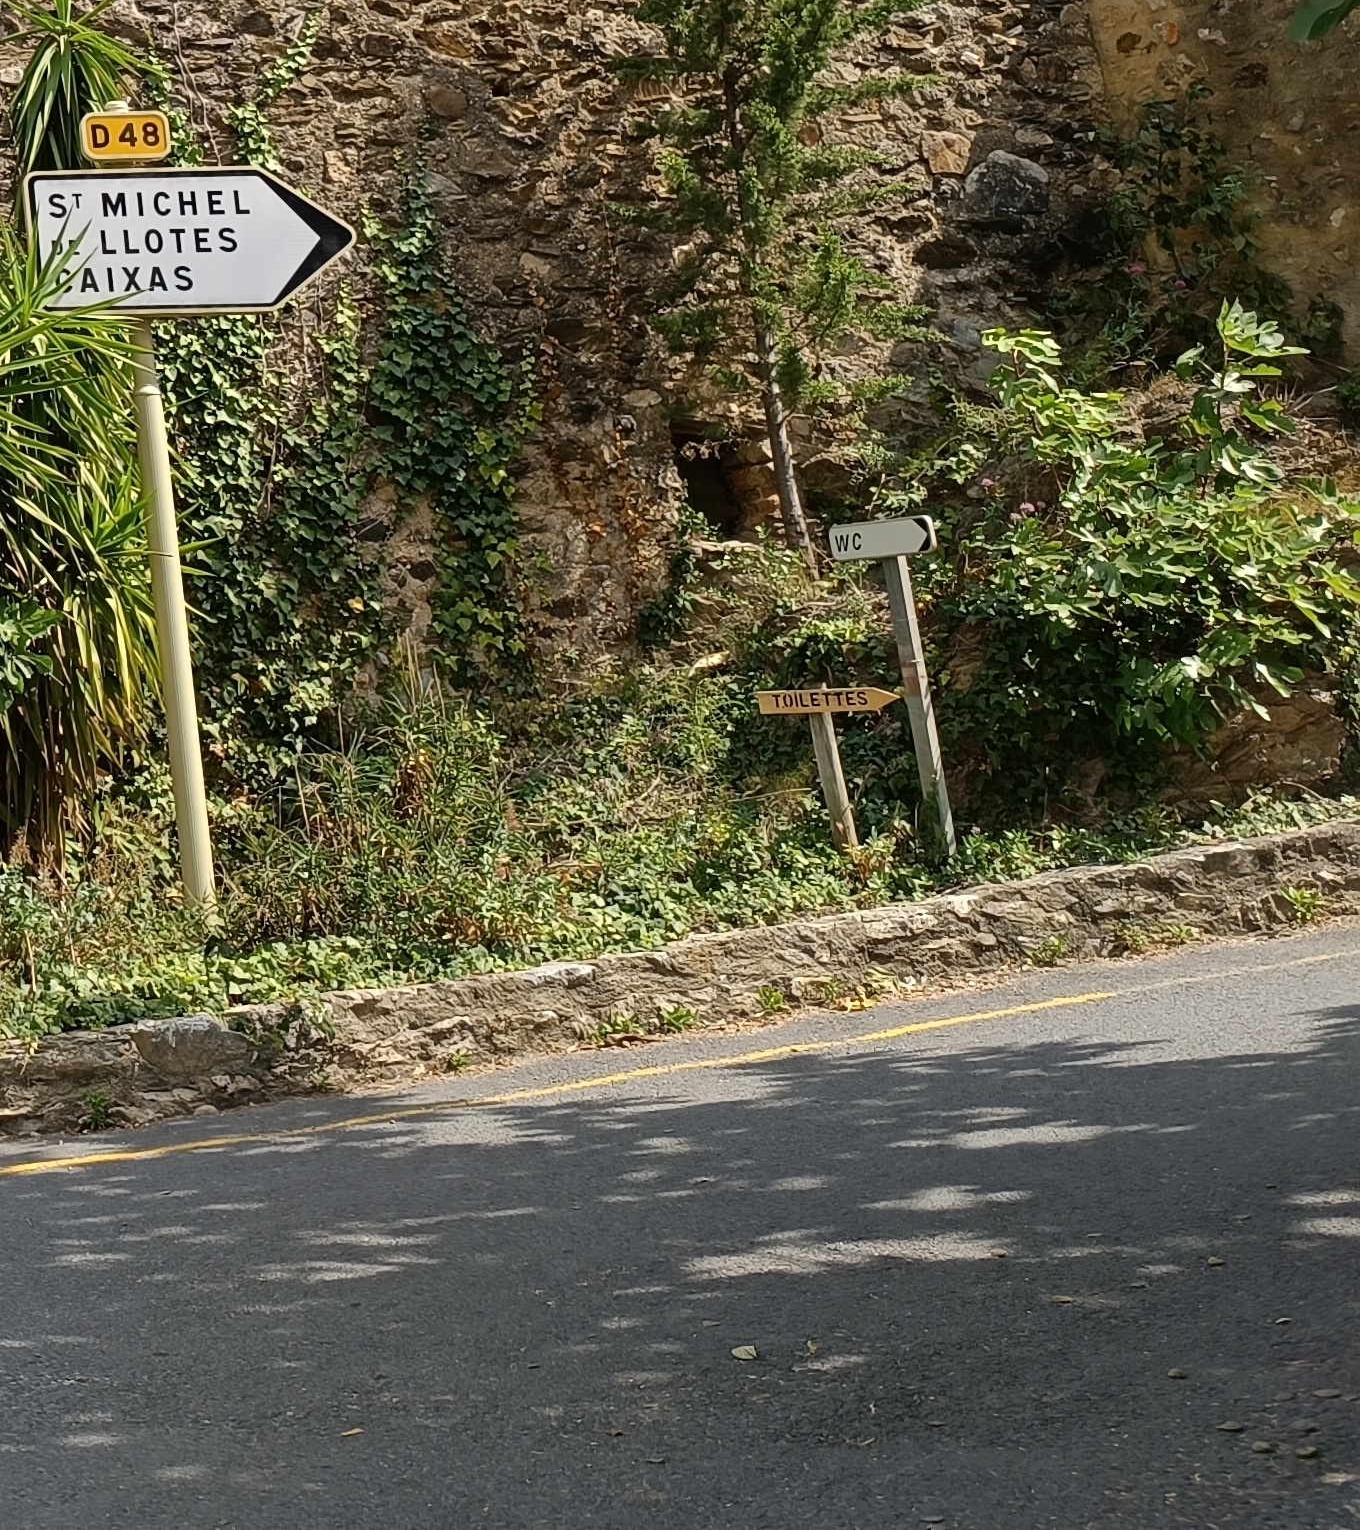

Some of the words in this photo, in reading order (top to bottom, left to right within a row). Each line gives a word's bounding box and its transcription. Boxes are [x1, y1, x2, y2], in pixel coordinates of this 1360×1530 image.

[101, 190, 250, 217] MICHEL
[100, 227, 238, 255] LLOTES
[55, 265, 194, 294] CAIXAS
[835, 532, 862, 553] WC
[771, 691, 868, 709] TOILETTES
